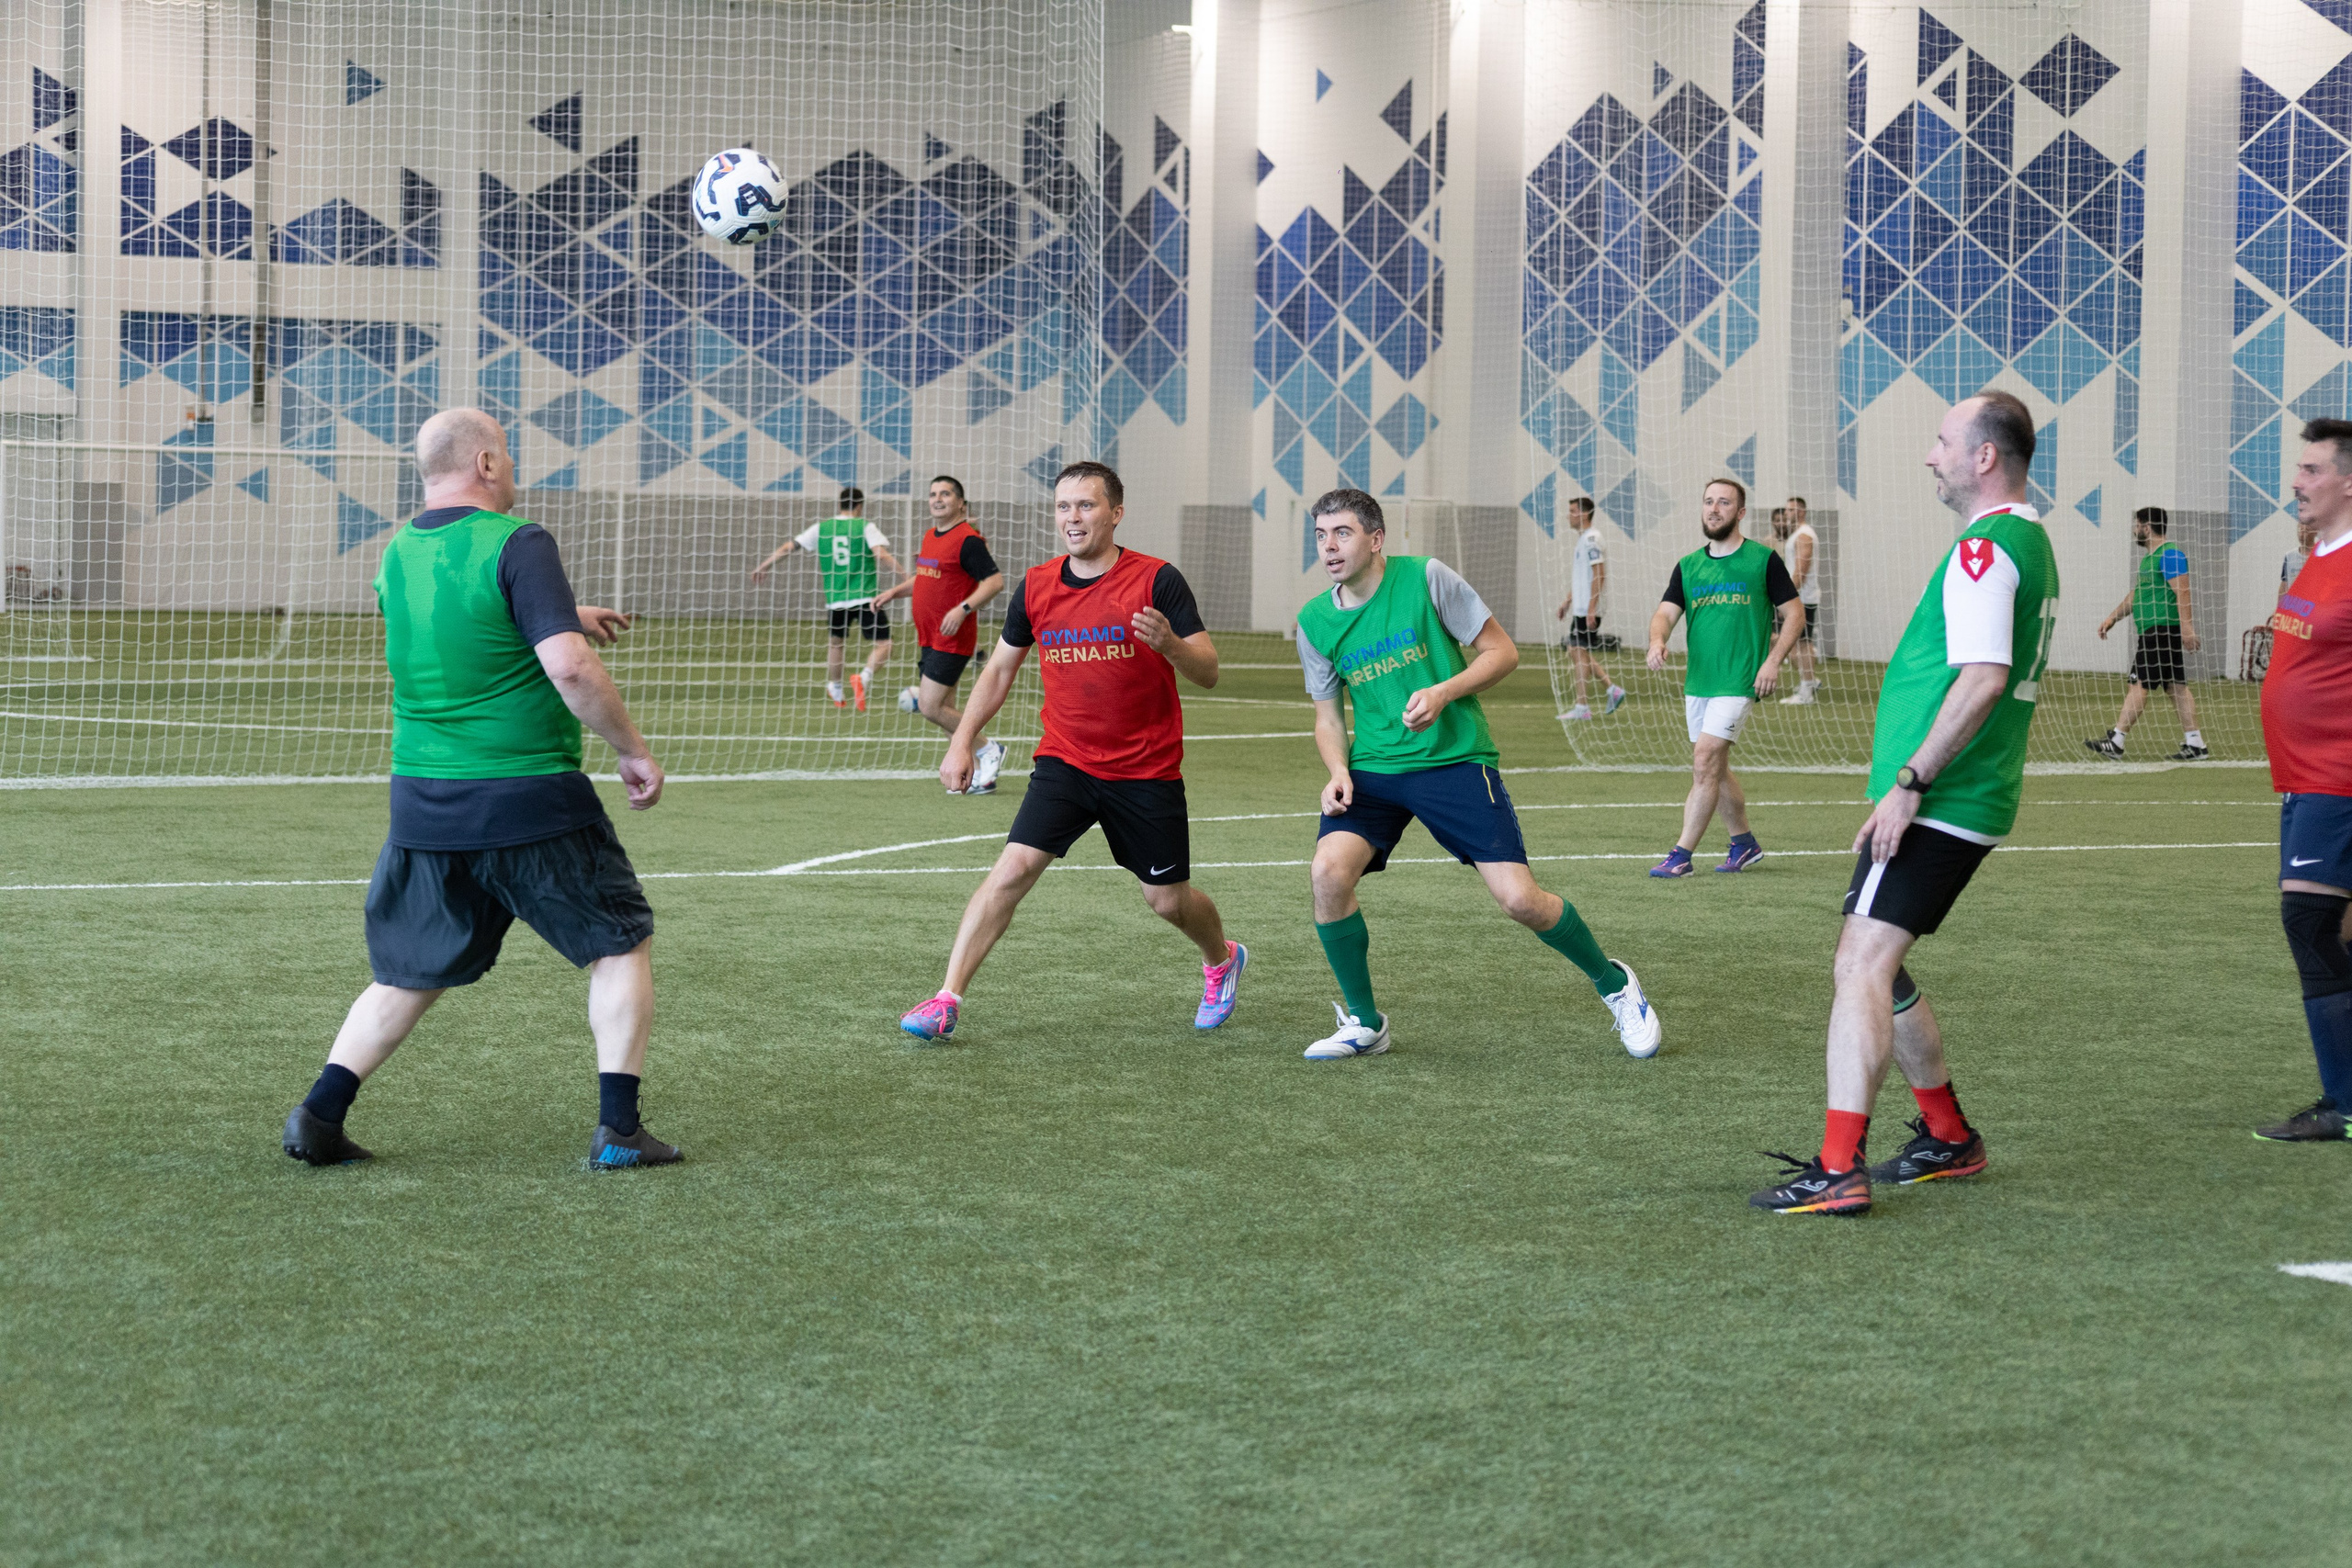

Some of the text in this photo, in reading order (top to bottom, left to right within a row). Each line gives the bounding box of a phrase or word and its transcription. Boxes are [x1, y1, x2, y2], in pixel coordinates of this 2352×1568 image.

[832, 535, 850, 567] 6
[1692, 581, 1747, 598] DYNAMO
[1691, 593, 1750, 610] ARENA.RU
[1042, 626, 1125, 646] DYNAMO
[1045, 643, 1135, 663] ARENA.RU
[1341, 627, 1417, 671] DYNAMO
[1346, 643, 1429, 687] ARENA.RU
[598, 1144, 641, 1168] NIKE
